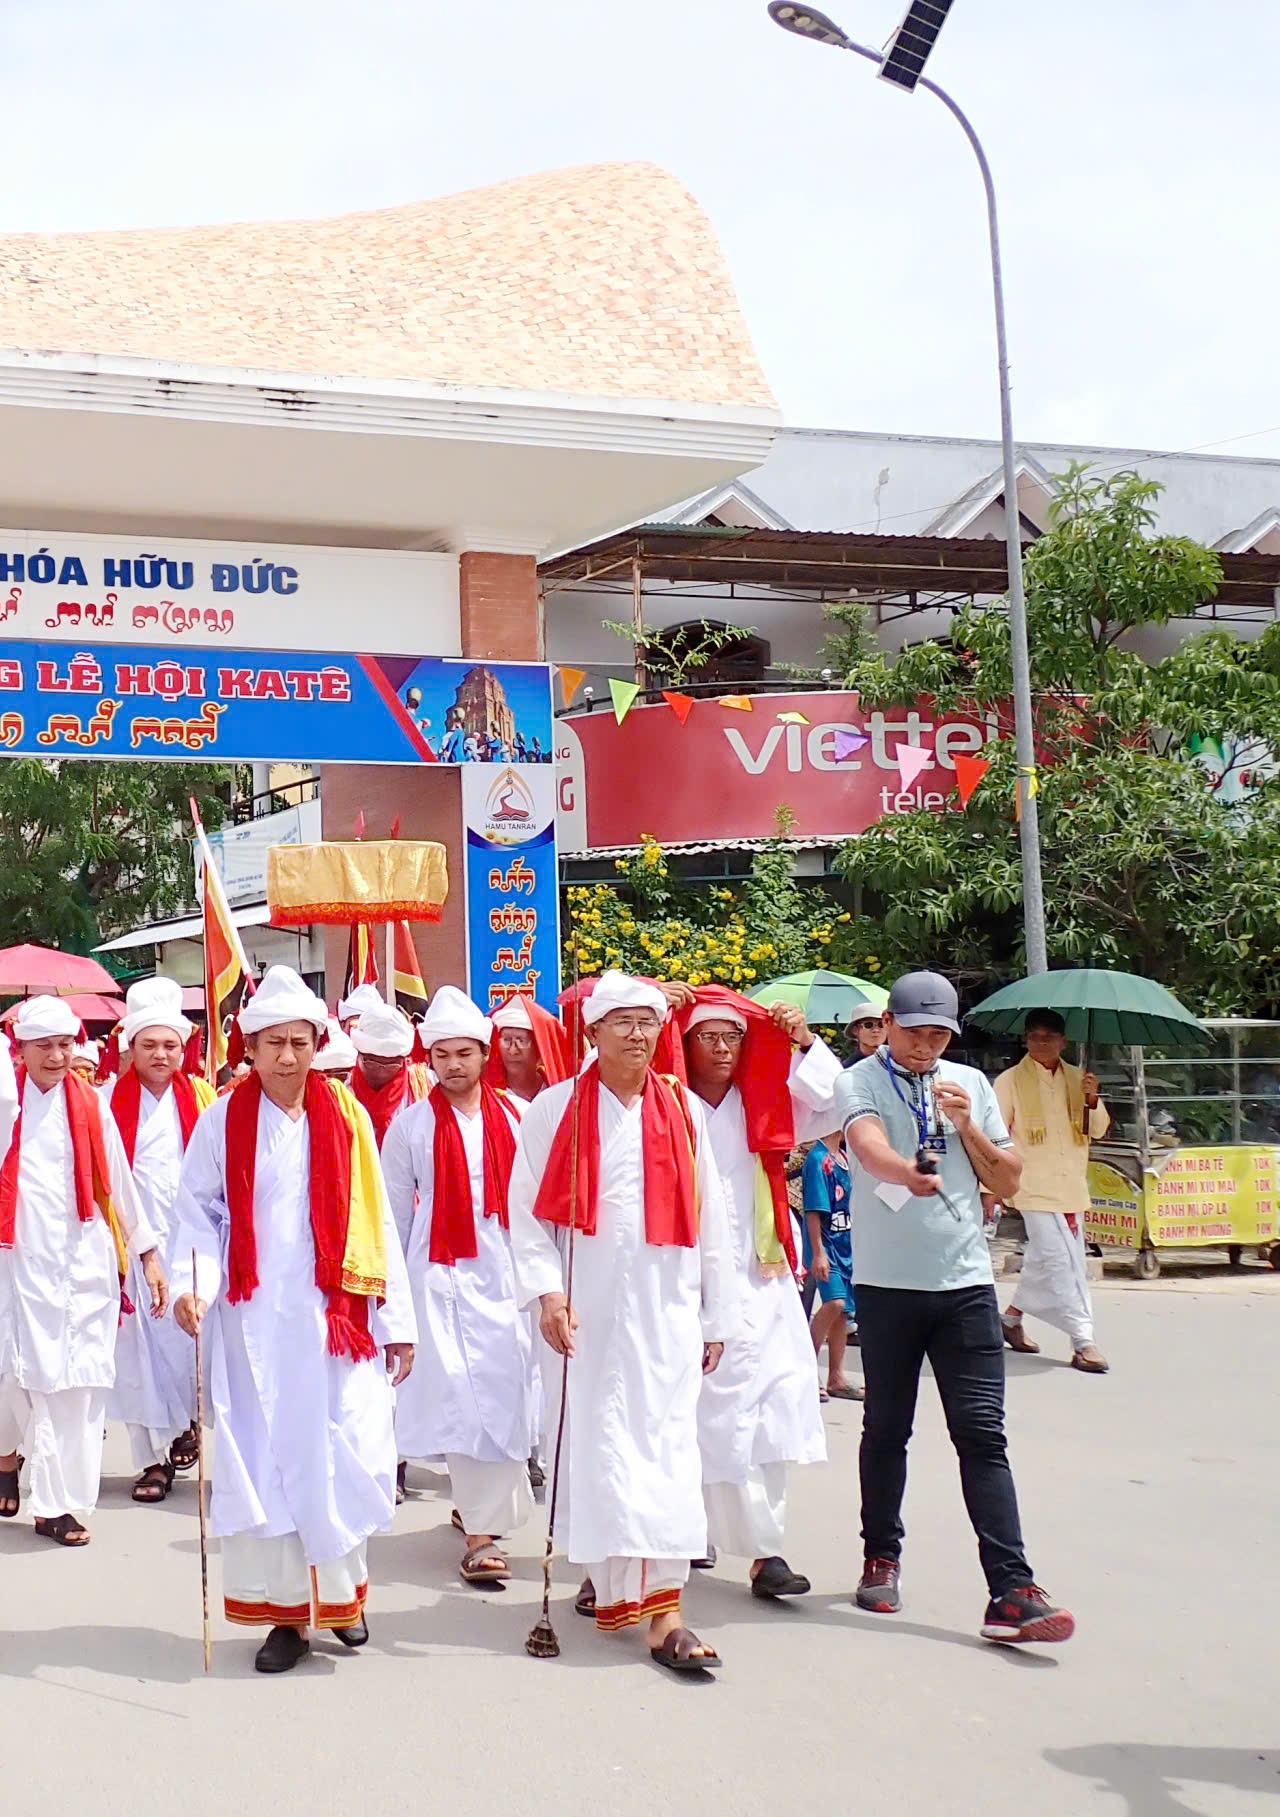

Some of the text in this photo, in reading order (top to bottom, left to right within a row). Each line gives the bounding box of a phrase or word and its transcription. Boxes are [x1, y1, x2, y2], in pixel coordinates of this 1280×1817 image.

[103, 554, 193, 590] HỮU
[211, 558, 299, 595] ĐỨC
[36, 652, 104, 692] LỄ
[115, 660, 212, 702] HỘI
[218, 666, 352, 702] KATÊ
[485, 822, 536, 830] HAMU TANRAN
